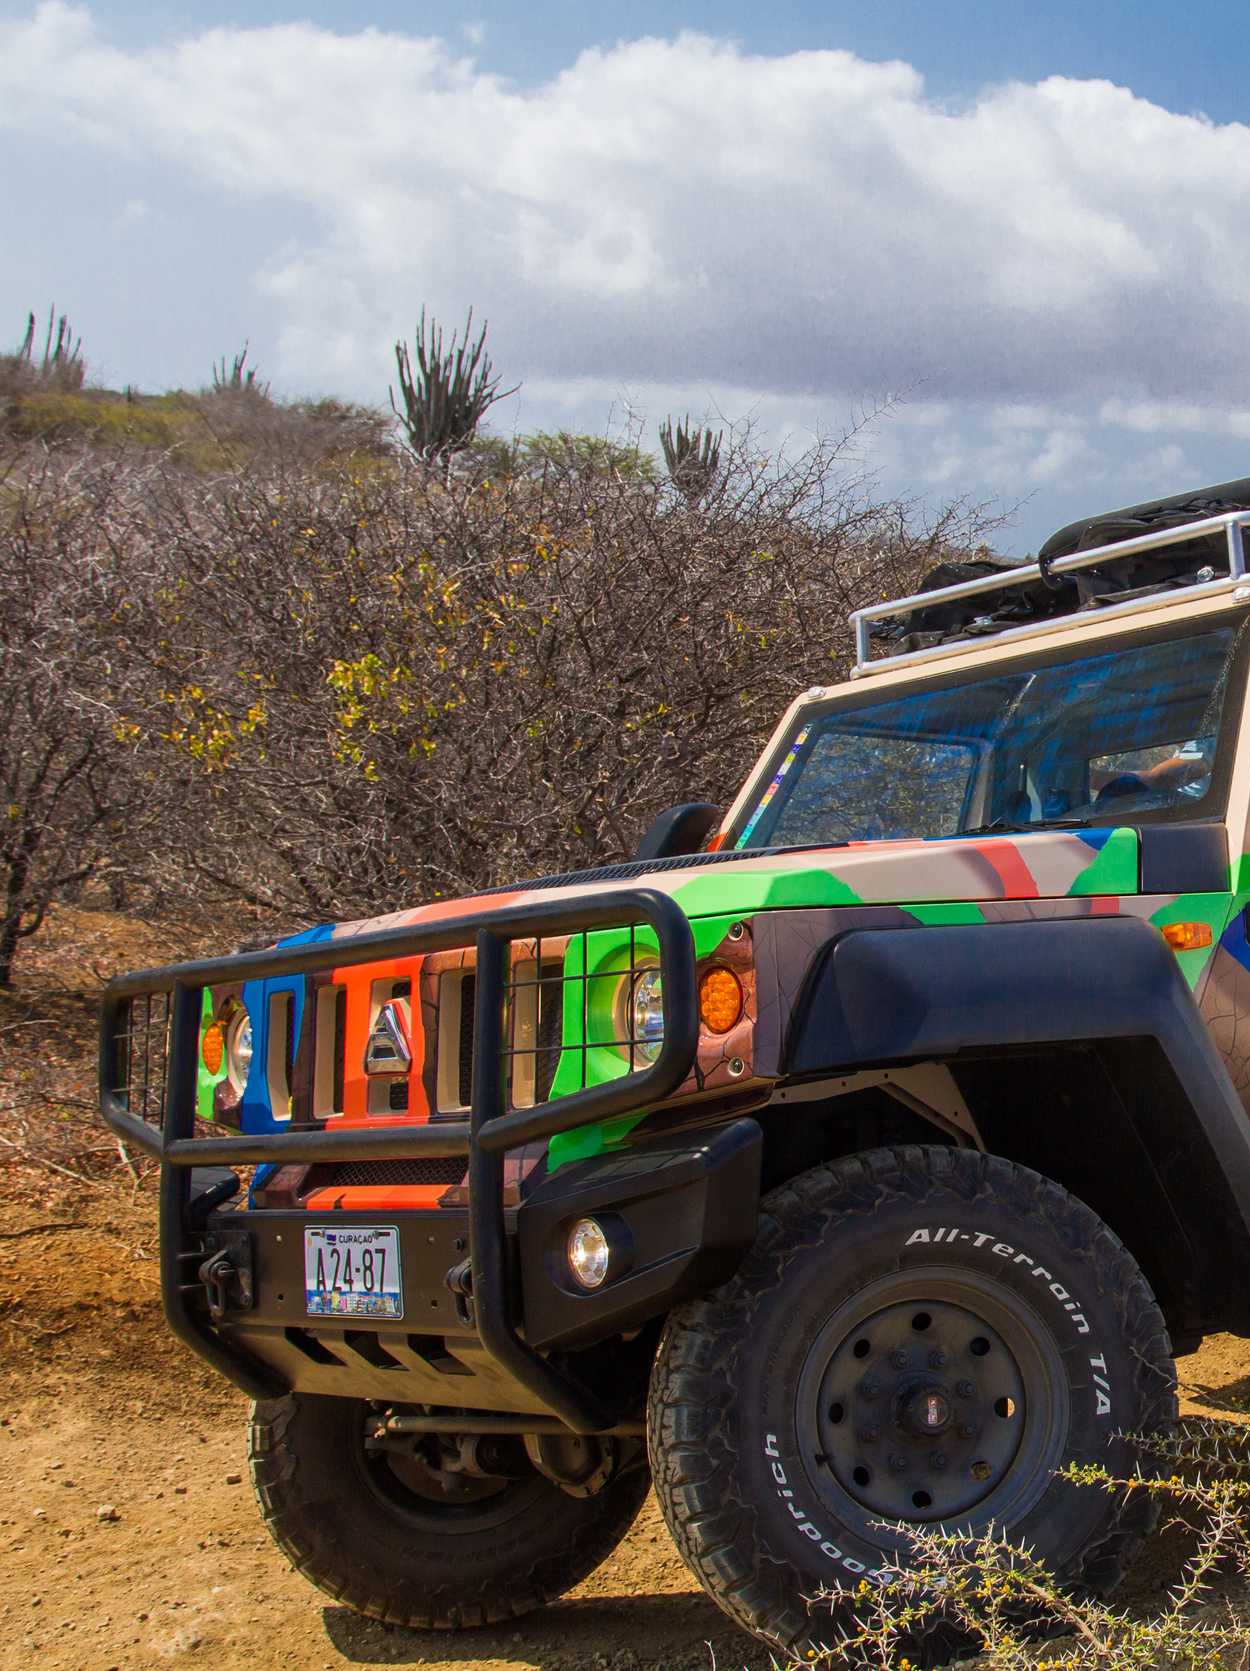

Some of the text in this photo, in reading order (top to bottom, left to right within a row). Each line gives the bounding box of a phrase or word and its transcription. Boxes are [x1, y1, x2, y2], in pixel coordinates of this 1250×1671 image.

[338, 1235, 373, 1244] CURAÇAO
[905, 1227, 1111, 1415] All-Terrain T/A
